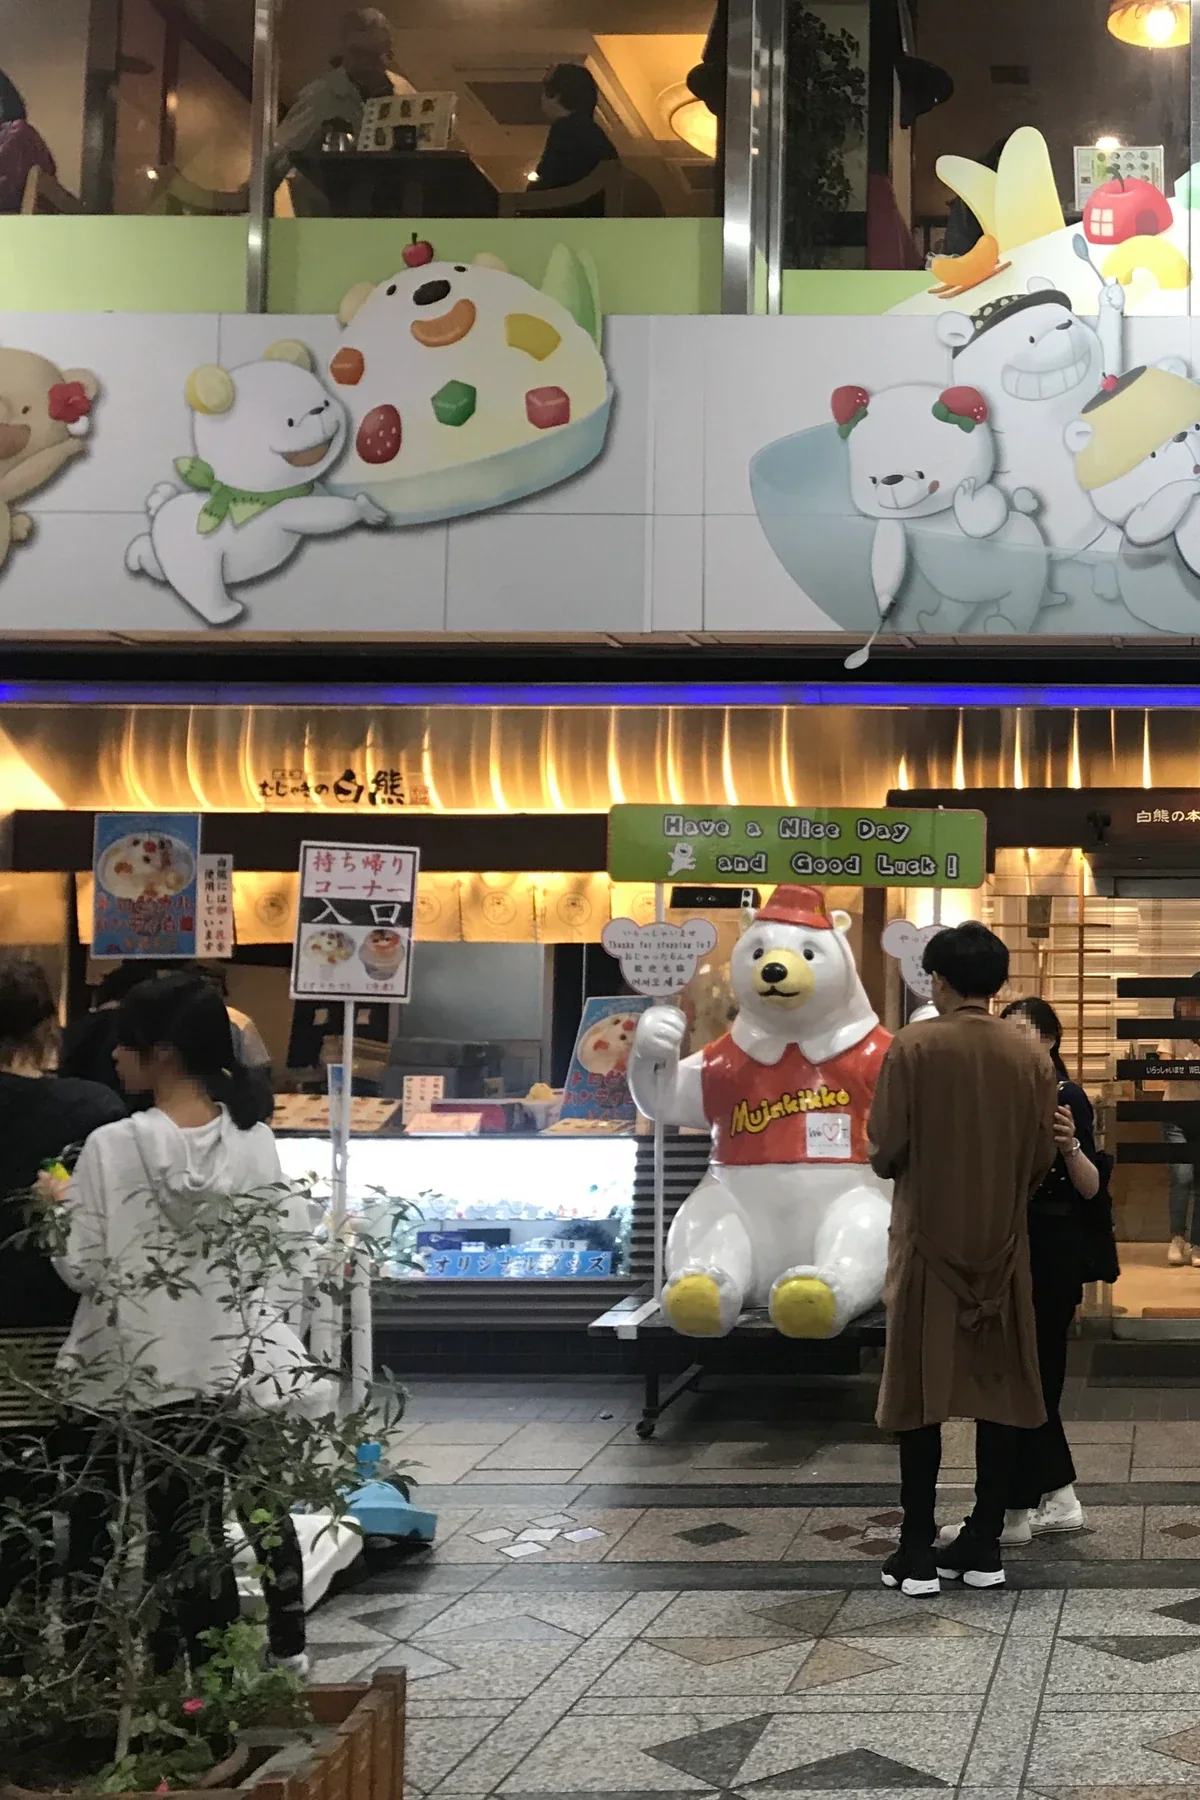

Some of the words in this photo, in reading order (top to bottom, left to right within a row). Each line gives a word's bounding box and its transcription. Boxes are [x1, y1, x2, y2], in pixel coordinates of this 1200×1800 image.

[663, 815, 731, 837] Have
[746, 819, 762, 837] a
[779, 817, 841, 839] Nice
[856, 818, 911, 843] Day
[312, 851, 404, 876] 持ち帰り
[716, 853, 768, 874] and
[791, 852, 861, 876] Good
[876, 854, 938, 878] Luck
[314, 879, 406, 898] コーナー
[311, 898, 402, 924] 入口
[1146, 1066, 1184, 1075] いらっしゃいませ
